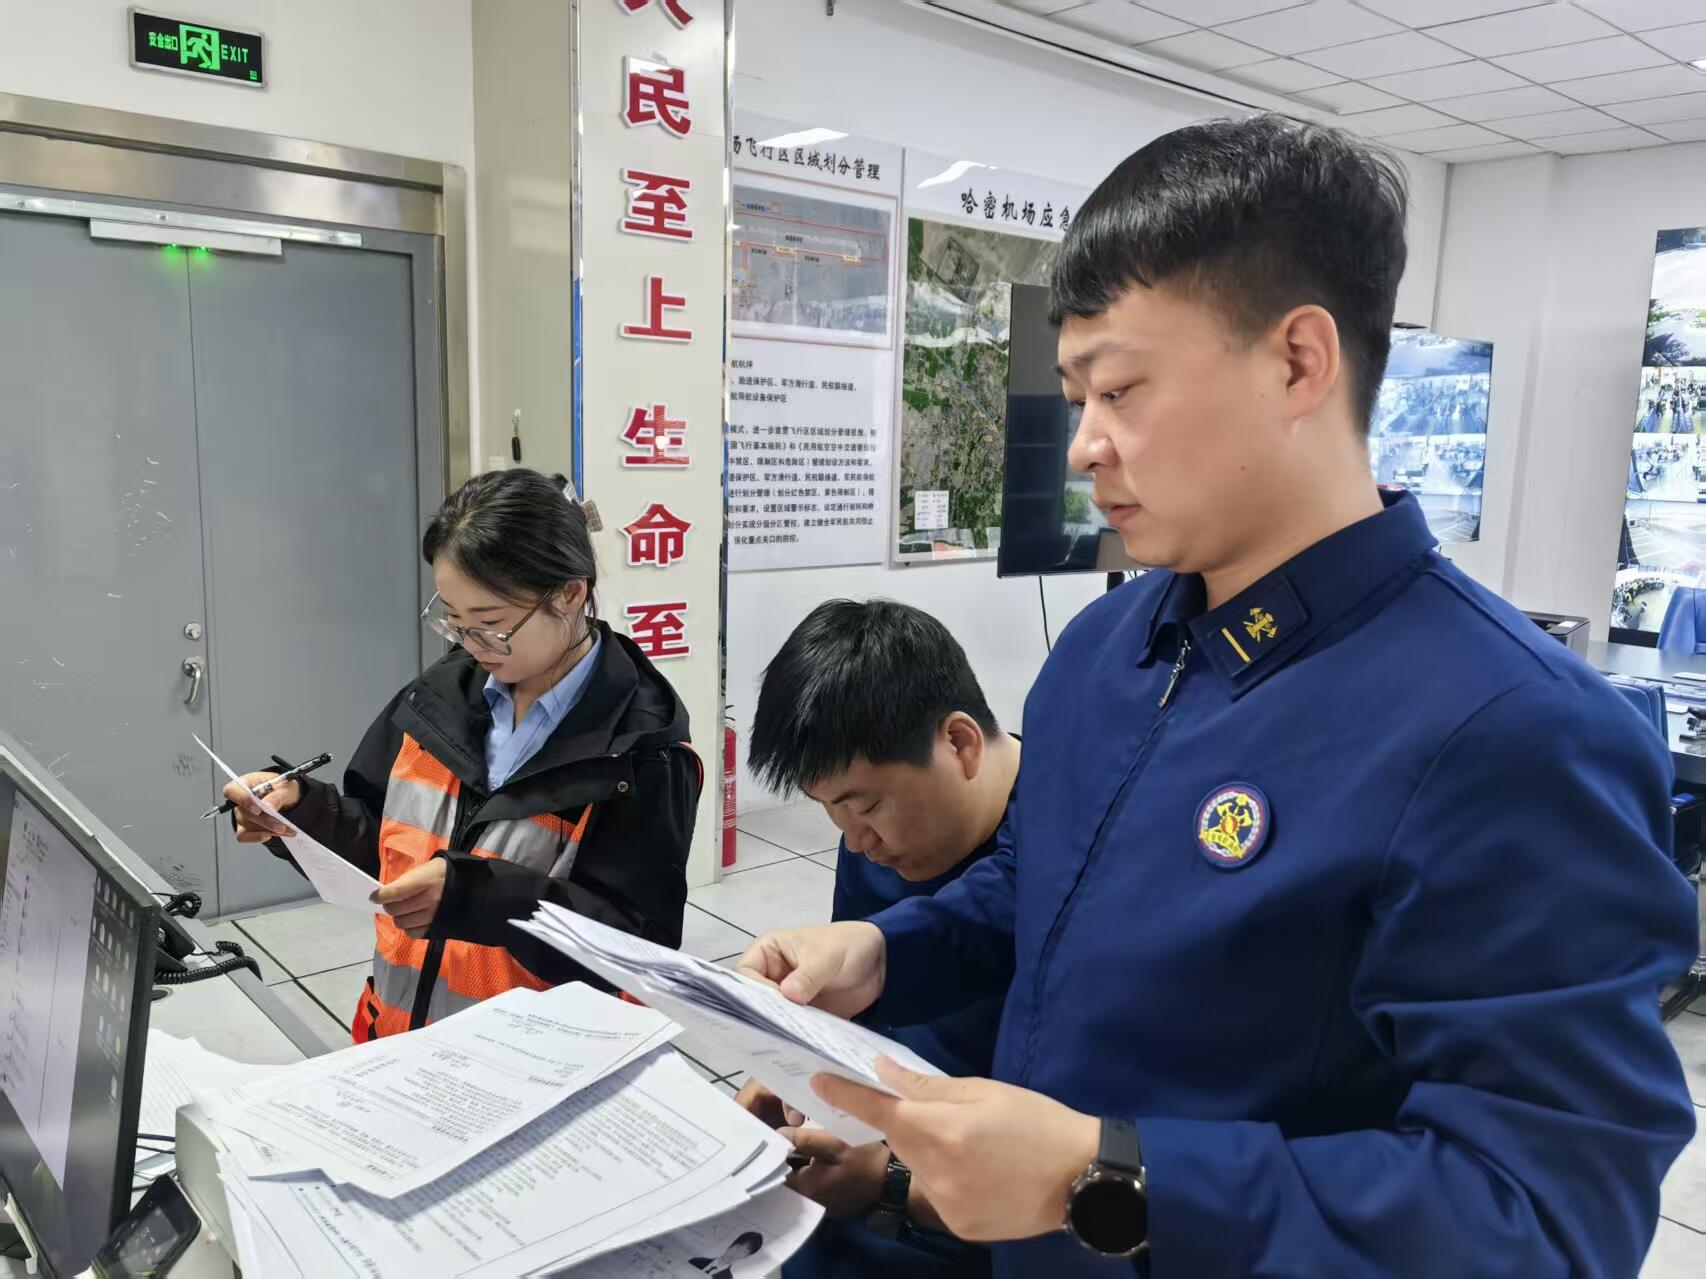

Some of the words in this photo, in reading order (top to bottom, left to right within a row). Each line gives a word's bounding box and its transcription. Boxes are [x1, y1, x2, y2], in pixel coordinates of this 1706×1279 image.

[148, 31, 178, 51] 安全出口
[220, 44, 249, 64] EXIT
[960, 187, 1071, 232] 哈密机场应急
